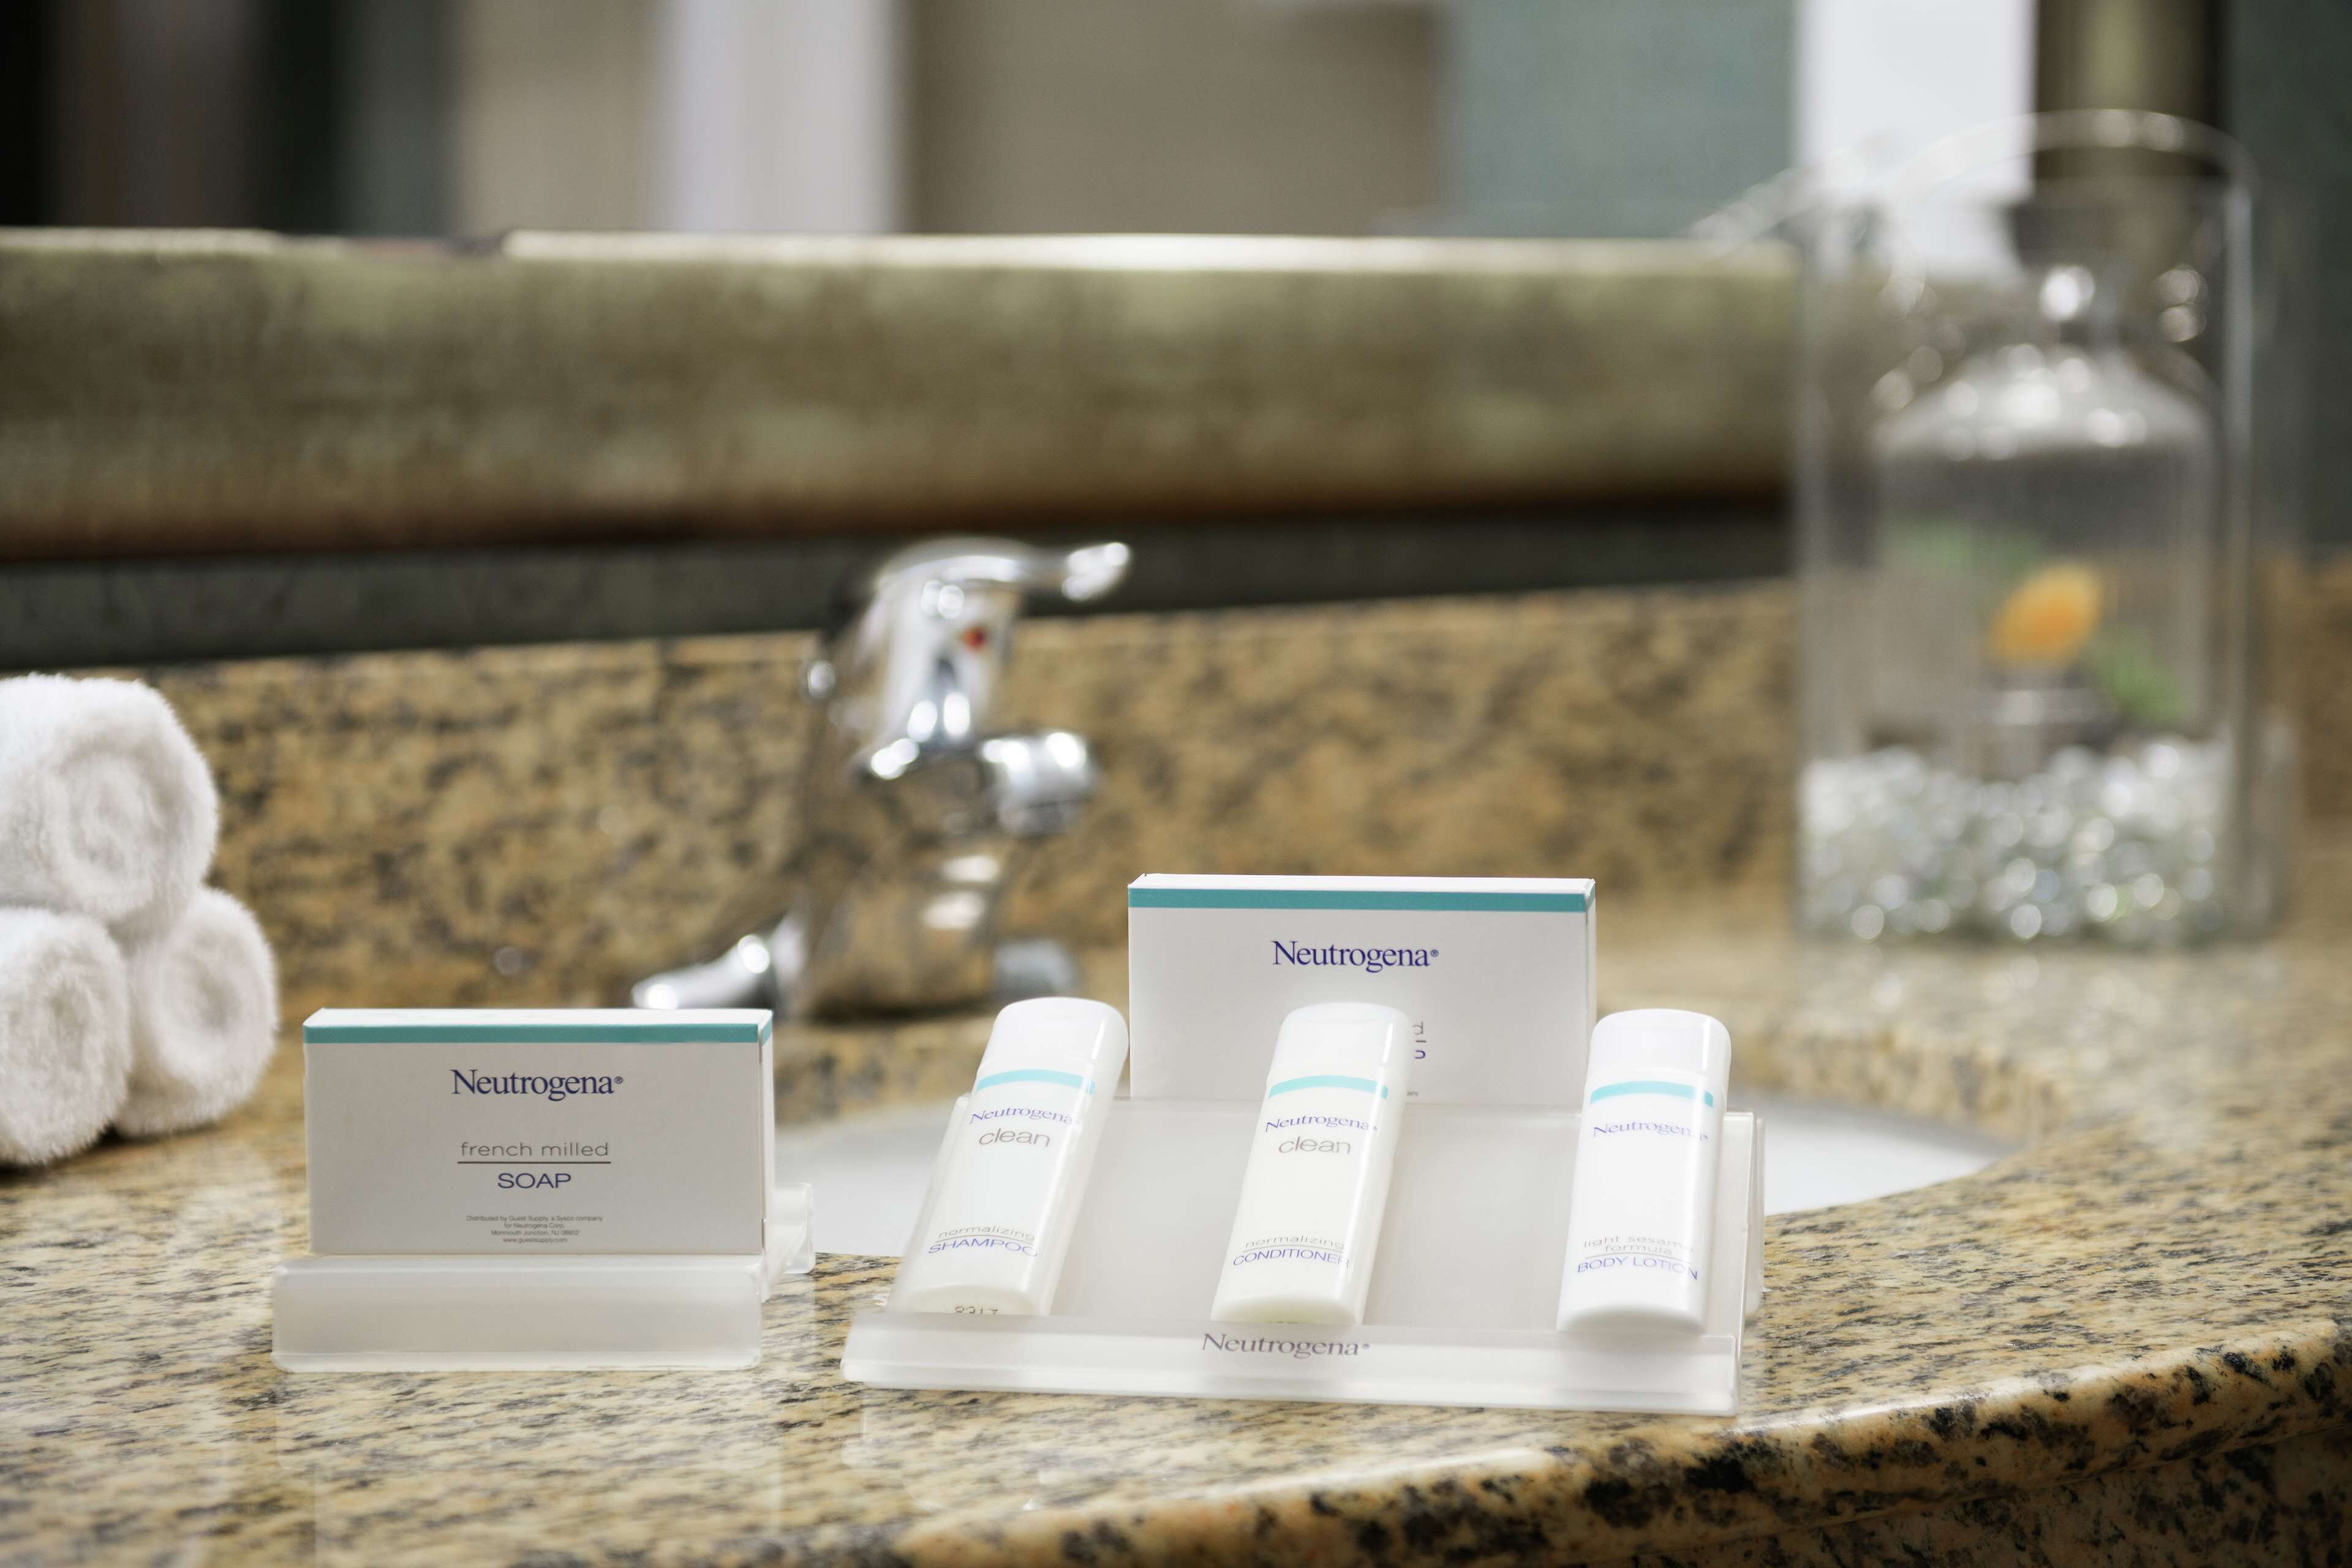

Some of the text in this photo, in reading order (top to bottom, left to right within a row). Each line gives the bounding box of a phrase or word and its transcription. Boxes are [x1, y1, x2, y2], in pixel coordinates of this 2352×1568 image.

[978, 1128, 1050, 1147] clean
[1278, 1136, 1351, 1155] clean
[461, 1142, 609, 1157] french milled
[497, 1172, 571, 1189] SOAP
[938, 1226, 1036, 1242] normalizing
[1584, 1235, 1621, 1249] light
[1245, 1235, 1344, 1251] normalizing
[1605, 1244, 1673, 1256] formula
[1577, 1256, 1698, 1281] BODY LOTION
